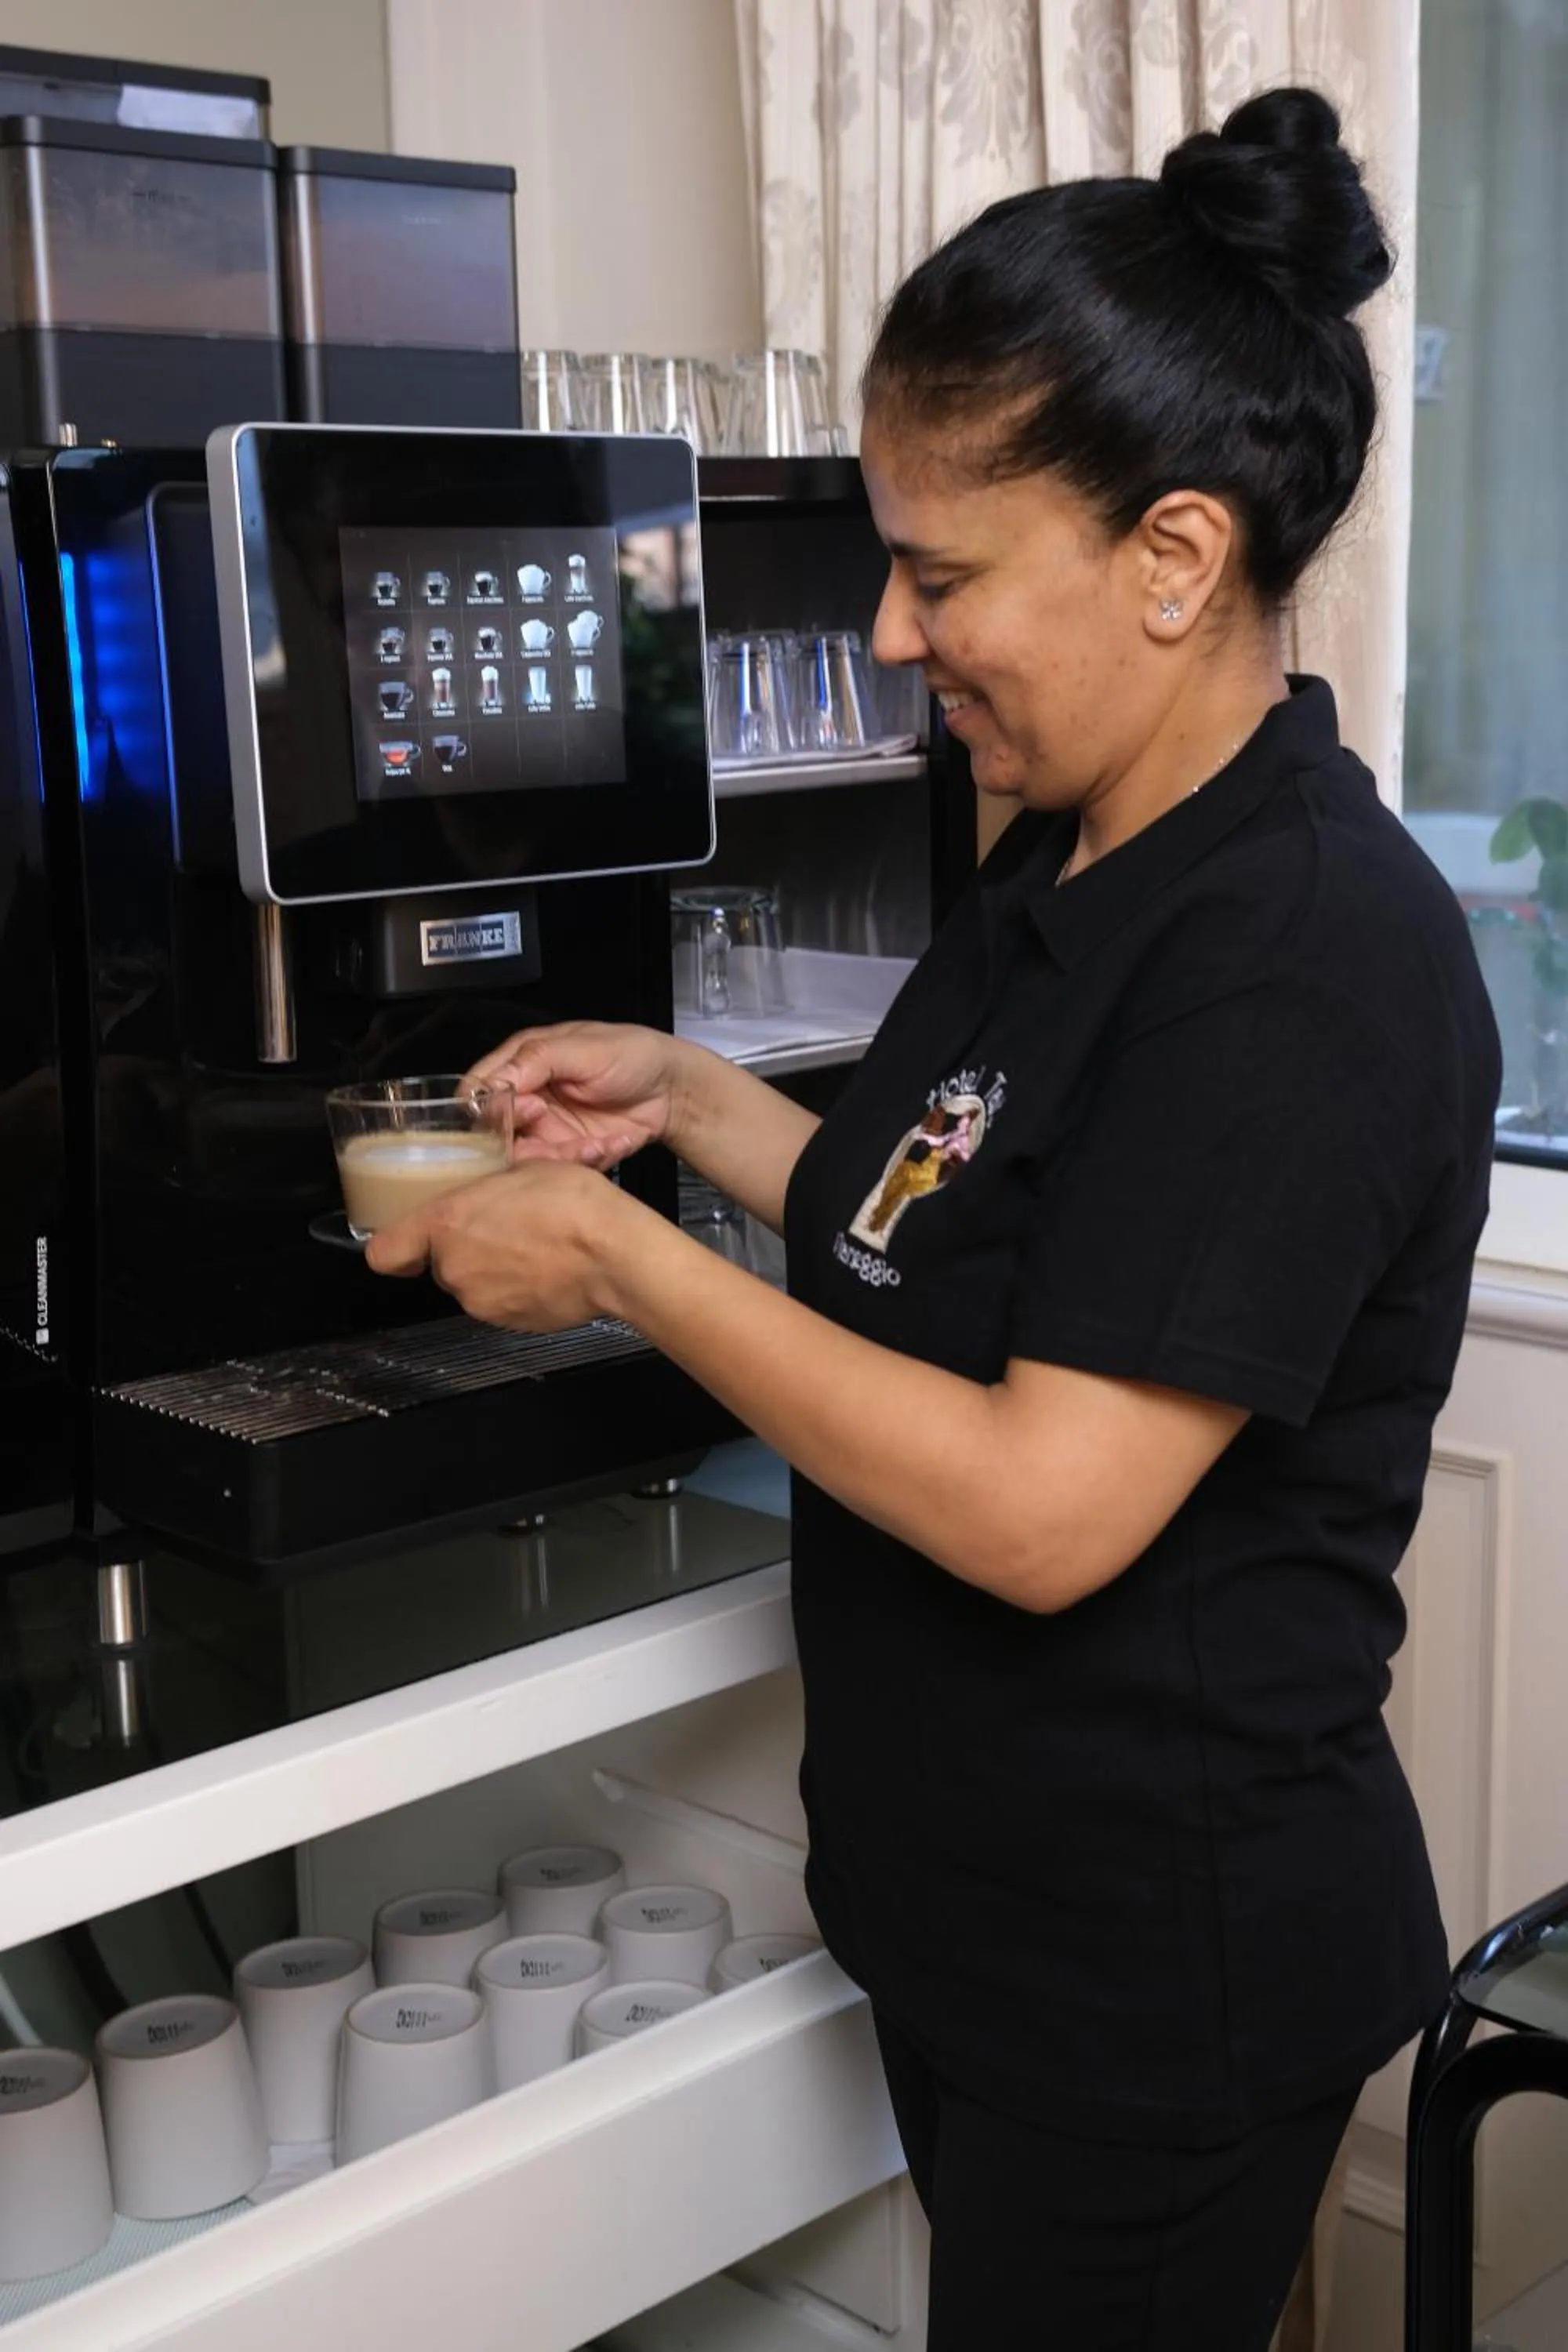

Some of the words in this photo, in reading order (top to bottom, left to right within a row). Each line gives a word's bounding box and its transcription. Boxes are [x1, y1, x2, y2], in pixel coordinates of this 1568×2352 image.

[429, 927, 503, 951] FRANKE
[926, 1065, 986, 1110] Hotel
[36, 1236, 48, 1326] CLEANMASTER
